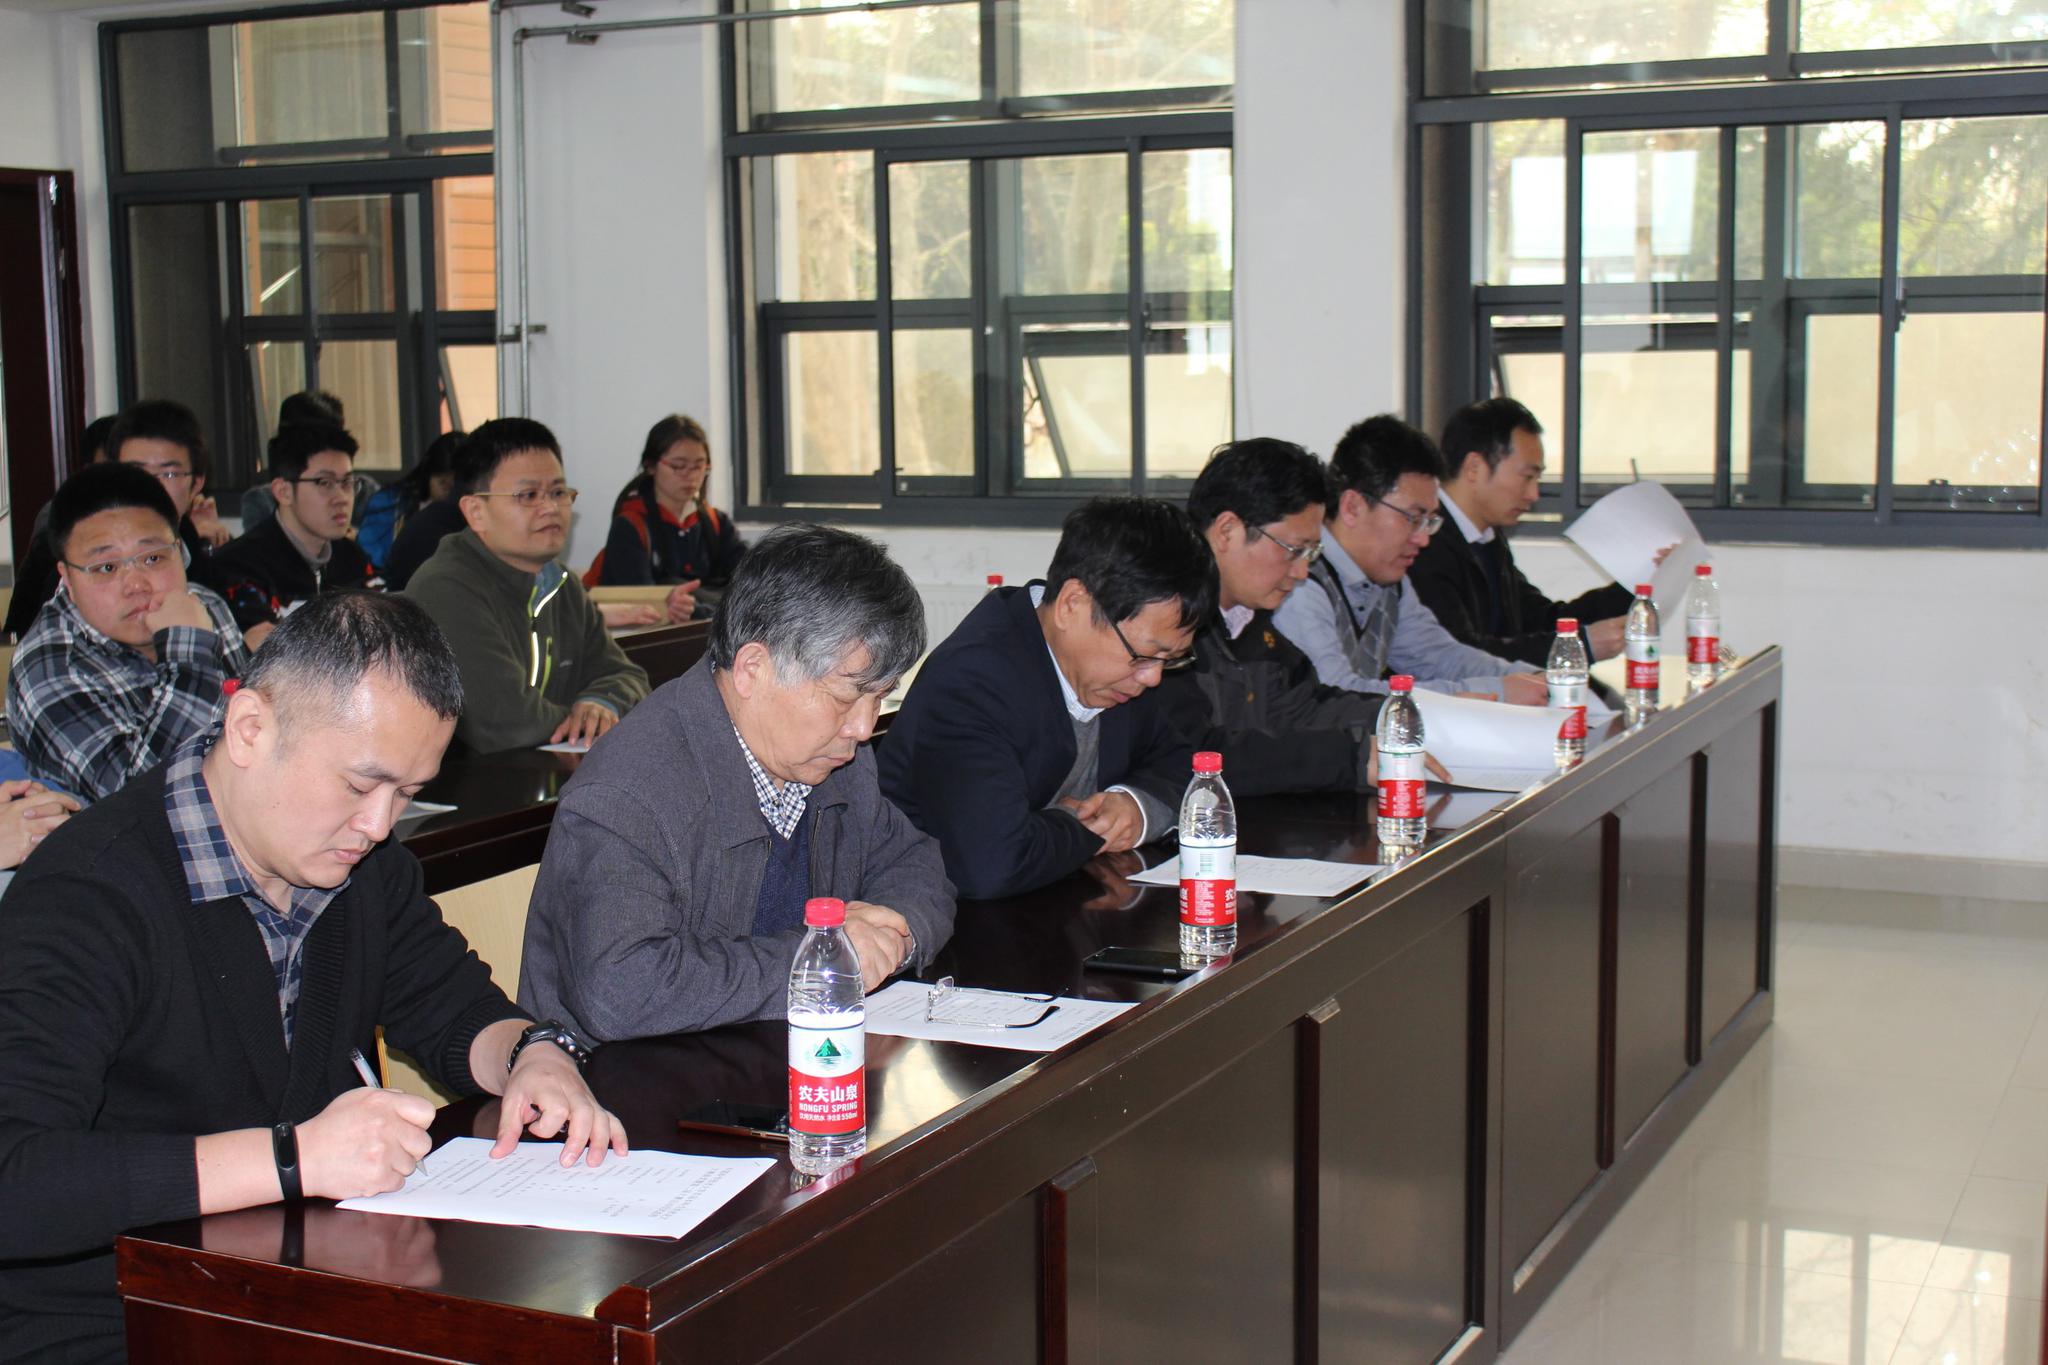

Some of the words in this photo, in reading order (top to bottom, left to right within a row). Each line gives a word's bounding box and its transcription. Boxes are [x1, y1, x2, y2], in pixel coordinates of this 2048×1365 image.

[799, 1084, 857, 1103] 农夫山泉
[831, 1101, 858, 1112] SPRING
